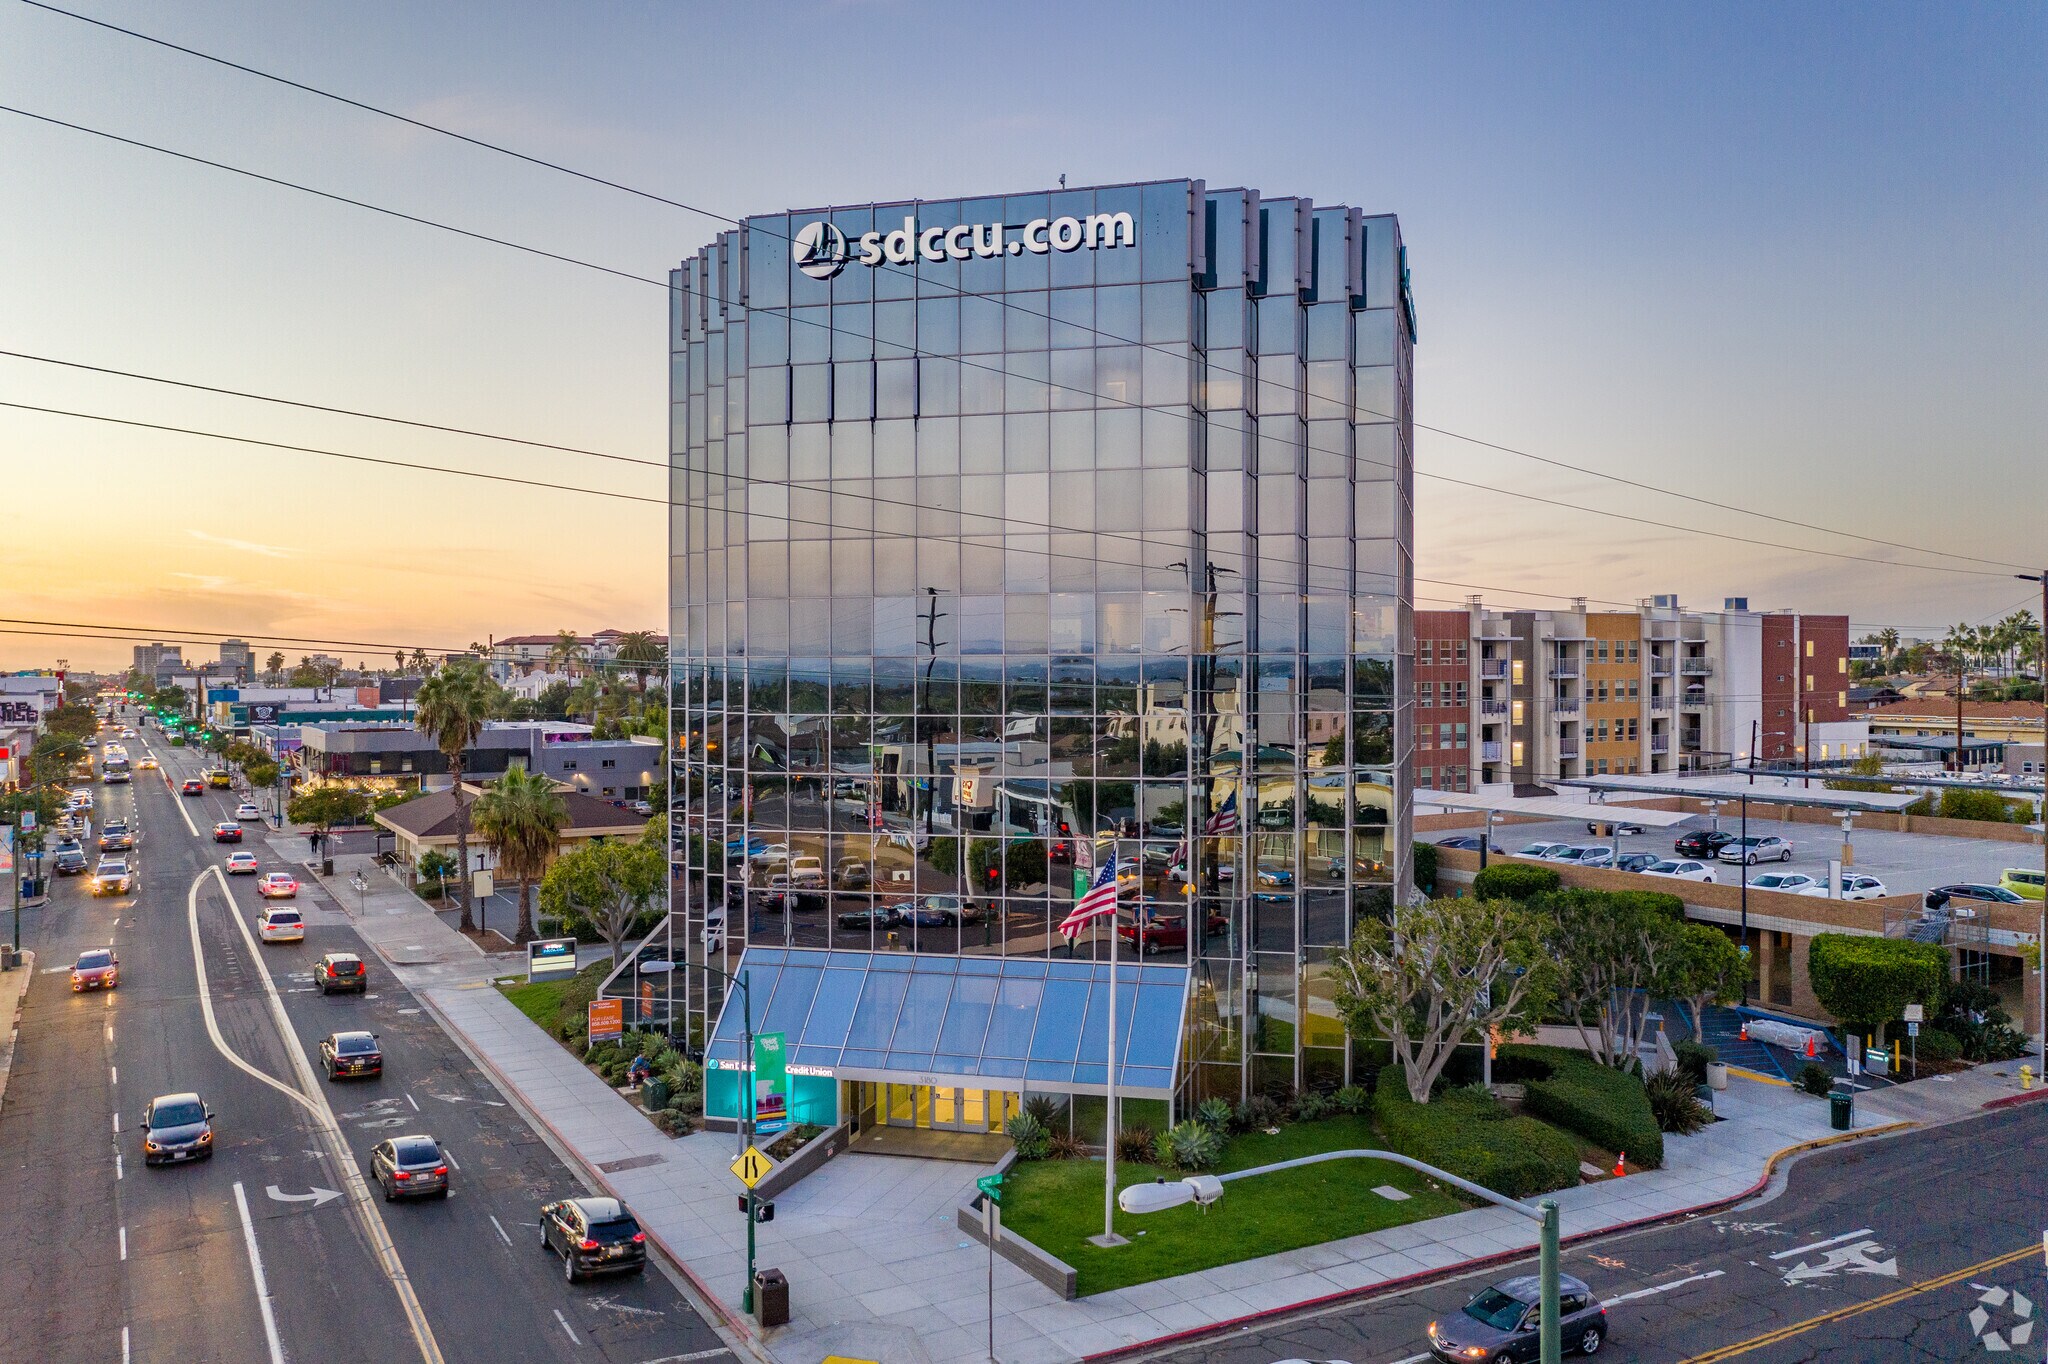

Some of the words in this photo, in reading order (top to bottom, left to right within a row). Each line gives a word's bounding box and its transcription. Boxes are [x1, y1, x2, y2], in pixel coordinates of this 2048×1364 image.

[860, 211, 1135, 264] sdccu.com
[720, 1061, 734, 1069] San
[785, 1065, 810, 1075] Credit
[810, 1067, 833, 1077] Union
[980, 1178, 992, 1187] 32nd
